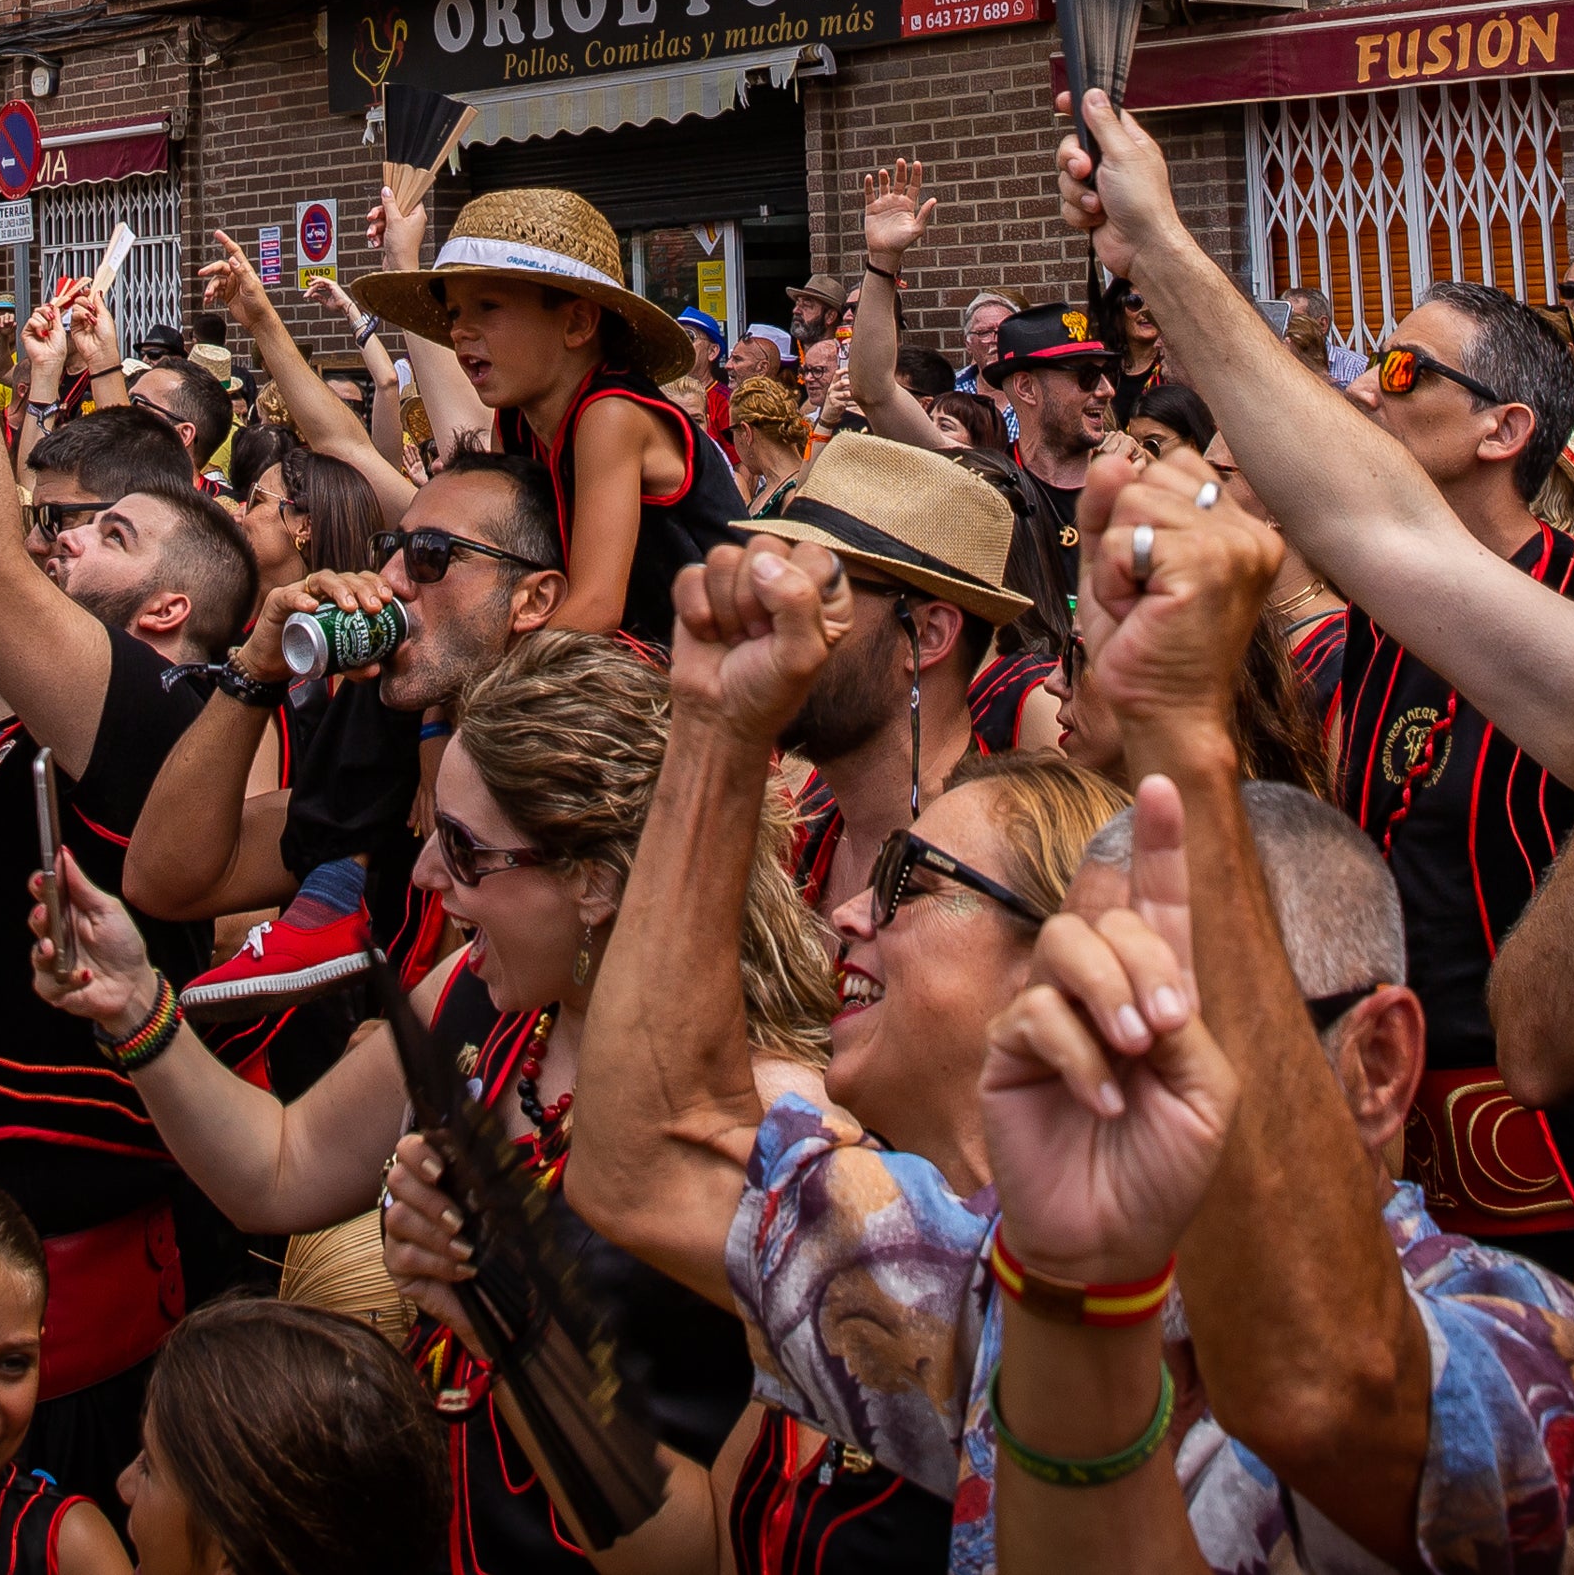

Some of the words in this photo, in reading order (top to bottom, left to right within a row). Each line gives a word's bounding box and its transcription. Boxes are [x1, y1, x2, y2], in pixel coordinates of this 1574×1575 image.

[925, 10, 951, 30] 643
[954, 5, 979, 26] 737
[983, 1, 1010, 21] 689
[503, 47, 575, 81] Pollos,
[584, 28, 693, 69] Comidas
[700, 33, 716, 61] y
[724, 14, 809, 51] mucho
[819, 2, 876, 37] más
[1355, 11, 1560, 84] FUSIÓN
[0, 205, 29, 218] TERRAZA
[304, 268, 331, 277] AVISO
[506, 256, 547, 271] ORIHUELA
[1382, 715, 1408, 781] COMPARSA
[1406, 706, 1440, 724] NEGR
